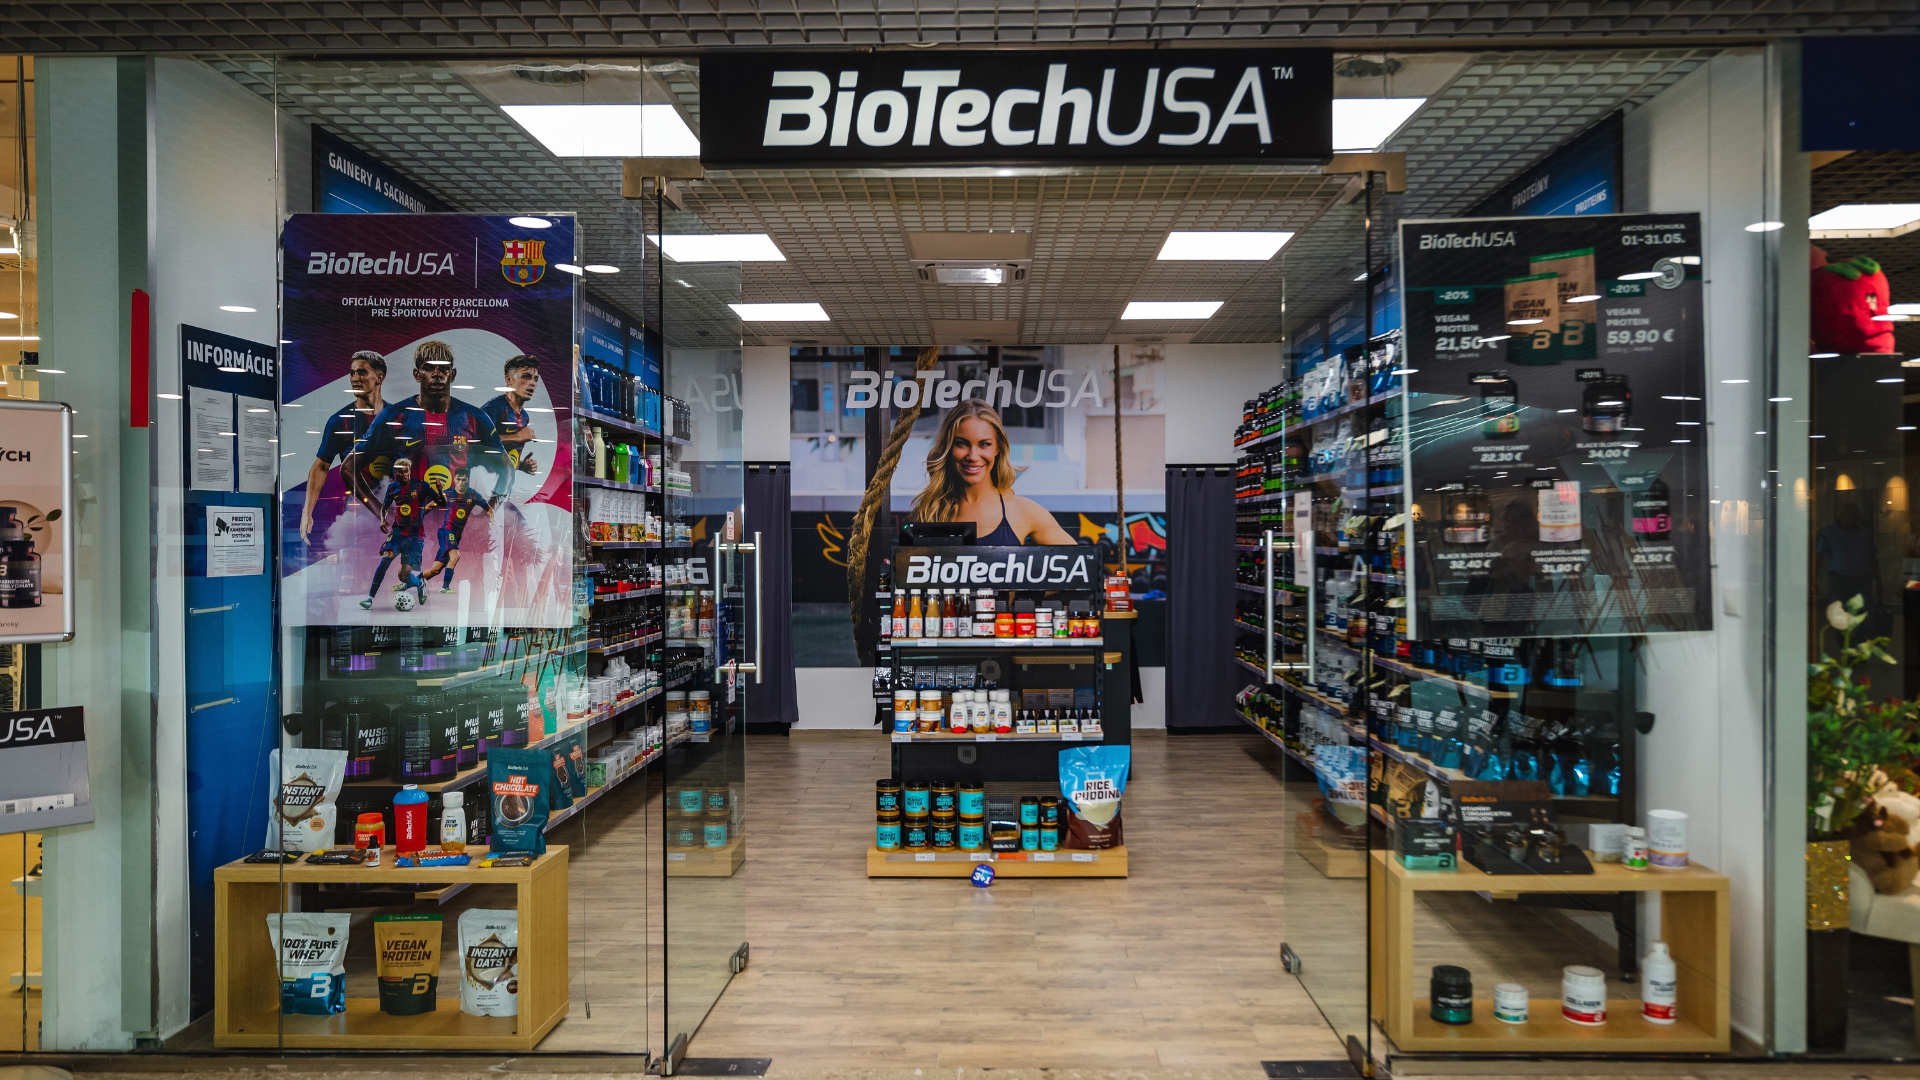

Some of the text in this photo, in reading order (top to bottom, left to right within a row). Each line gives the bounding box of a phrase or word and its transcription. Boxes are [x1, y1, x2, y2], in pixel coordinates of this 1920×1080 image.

[763, 63, 1273, 147] BioTechUSA
[328, 151, 373, 188] GAINERY
[375, 177, 382, 193] A
[1575, 189, 1607, 215] PROTEINS
[1419, 232, 1516, 250] BioTechUSA
[1621, 233, 1686, 246] 01-31.05.
[307, 251, 455, 275] BioTechUSA
[341, 296, 510, 308] OFICIÁLNY PARTNER FC BARCELONA
[371, 306, 480, 318] PRE ŠPORTOVÚ VÝŽIVU
[1606, 308, 1641, 316] VEGAN
[1434, 314, 1470, 323] VEGAN
[1606, 318, 1650, 327] PROTEIN
[1435, 324, 1479, 334] PROTEIN
[1606, 329, 1660, 345] 59,90
[187, 339, 274, 377] INFORMÁCIE
[846, 368, 1102, 409] BioTechUSA
[906, 554, 1089, 584] BioTechUSA
[510, 776, 526, 784] HOT
[1085, 780, 1110, 791] RICE
[494, 783, 538, 793] CHOCOLATE
[285, 796, 311, 805] OATS
[1074, 789, 1120, 801] PUDDING
[309, 940, 339, 949] PURE
[386, 940, 427, 951] VEGAN
[289, 950, 325, 960] WHEY
[382, 951, 432, 961] PROTEIN
[471, 947, 516, 958] INSTANT
[475, 958, 504, 968] OATS
